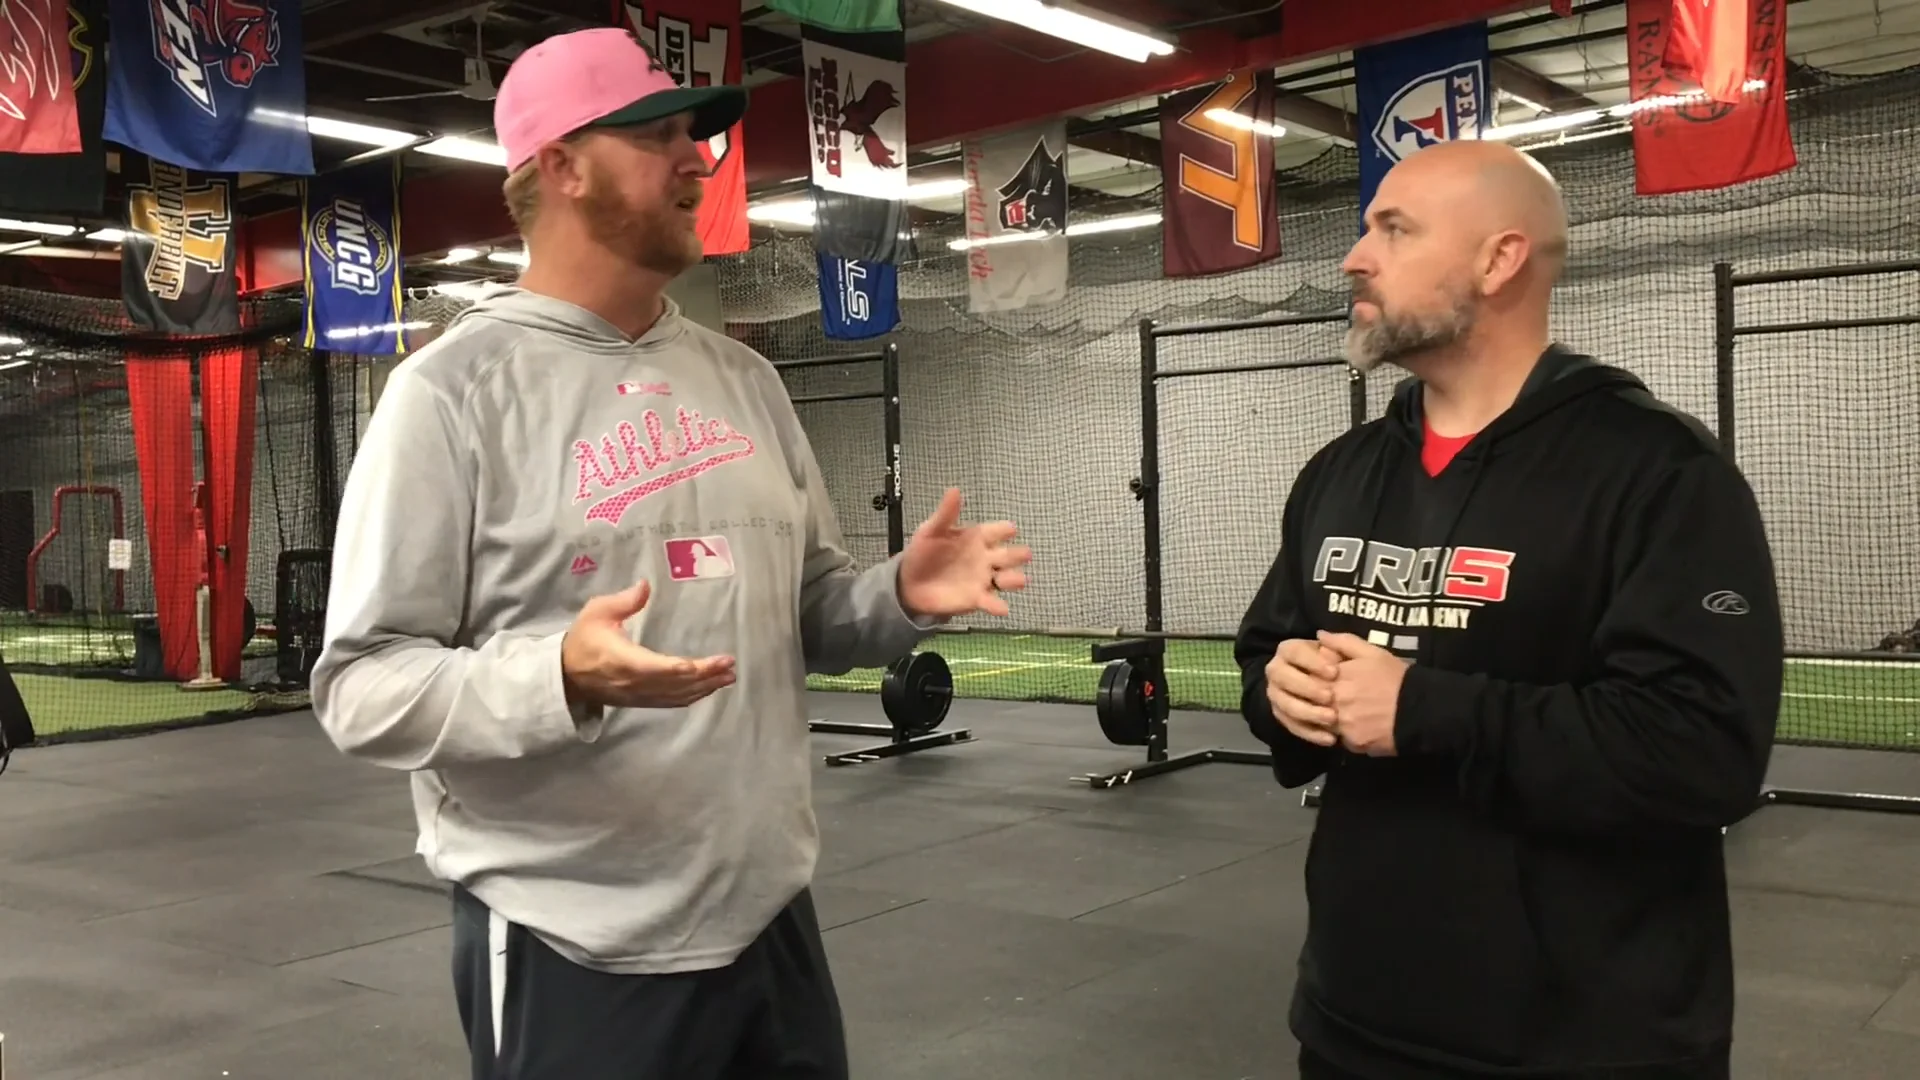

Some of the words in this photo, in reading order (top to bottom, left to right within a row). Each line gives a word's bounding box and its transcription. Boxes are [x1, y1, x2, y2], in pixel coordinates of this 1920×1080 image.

[1453, 73, 1479, 141] PEN
[148, 160, 184, 294] ANDERBILT
[335, 198, 376, 288] UNCG
[844, 258, 870, 322] LS
